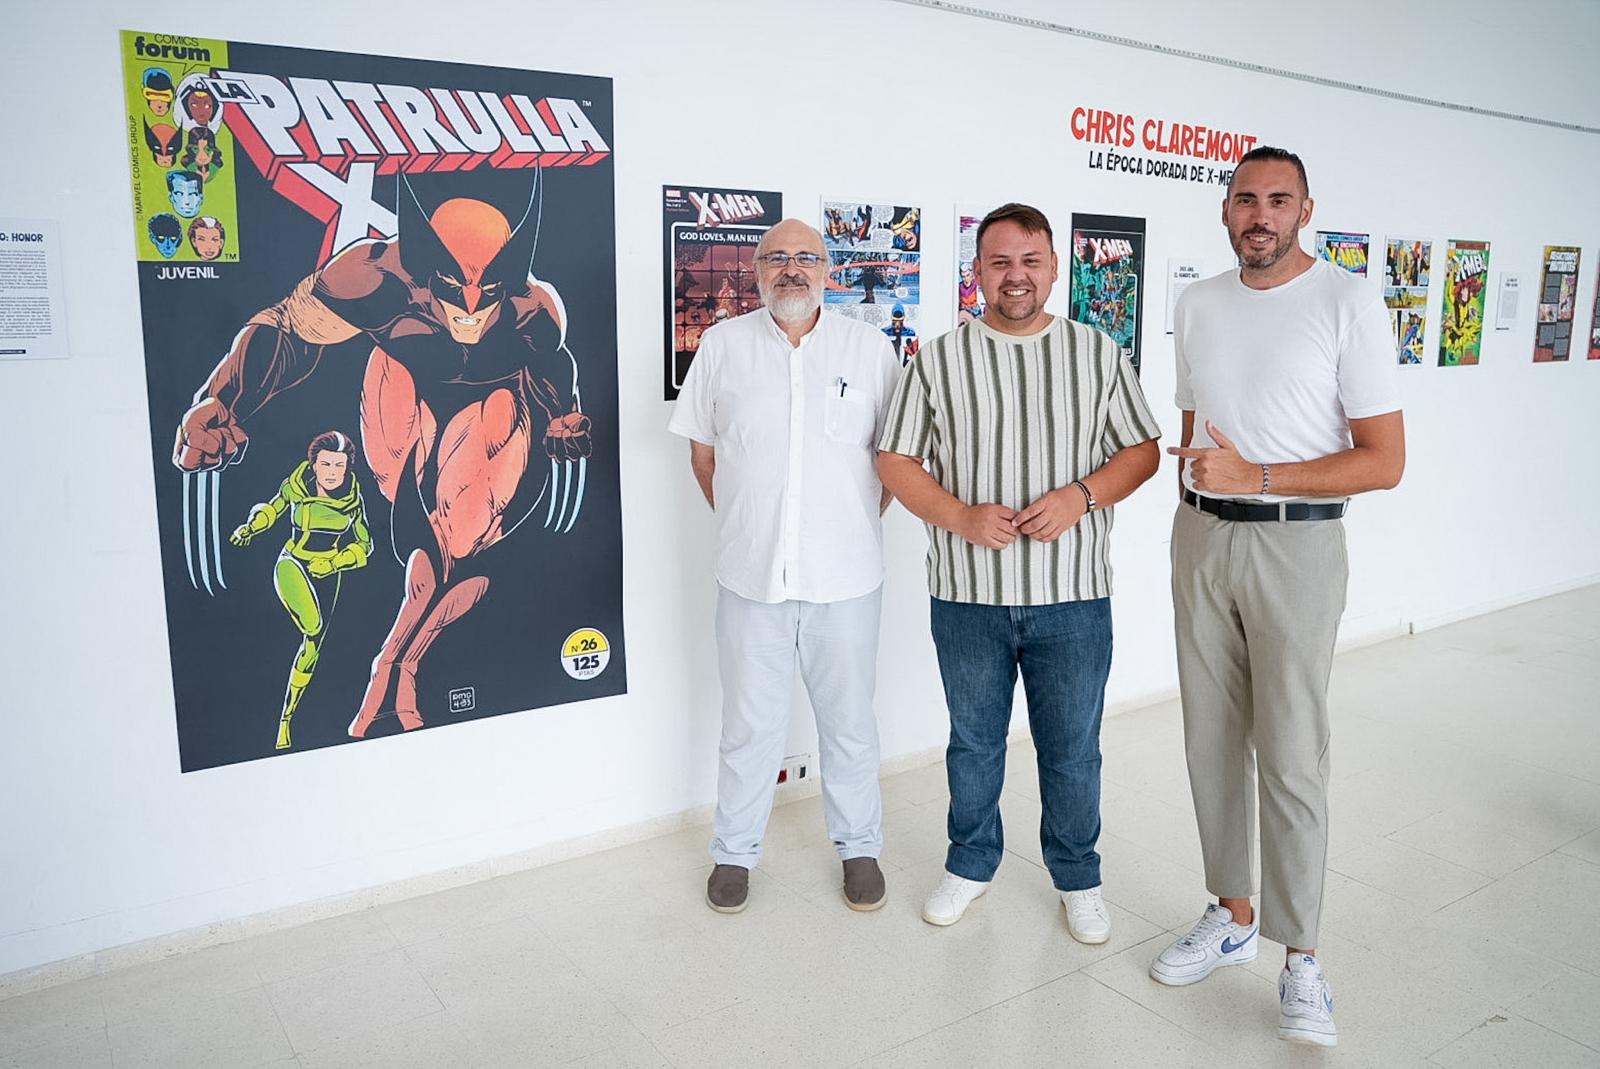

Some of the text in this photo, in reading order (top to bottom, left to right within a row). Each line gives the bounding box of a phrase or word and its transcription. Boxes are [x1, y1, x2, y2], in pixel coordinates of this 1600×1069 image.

[154, 33, 199, 46] COMICS
[135, 36, 210, 62] forum
[210, 81, 251, 100] LA
[215, 70, 611, 168] PATRULLA
[1070, 107, 1257, 163] CHRIS CLAREMONT
[1089, 147, 1233, 186] LA ÉPOCA DORADA DE X-ME
[688, 191, 765, 228] X-MEN
[11, 232, 44, 243] HONOR
[679, 231, 698, 240] GOD
[727, 233, 746, 242] MAN
[157, 266, 219, 279] JUVENIL
[580, 638, 597, 651] 26
[573, 655, 600, 670] 125
